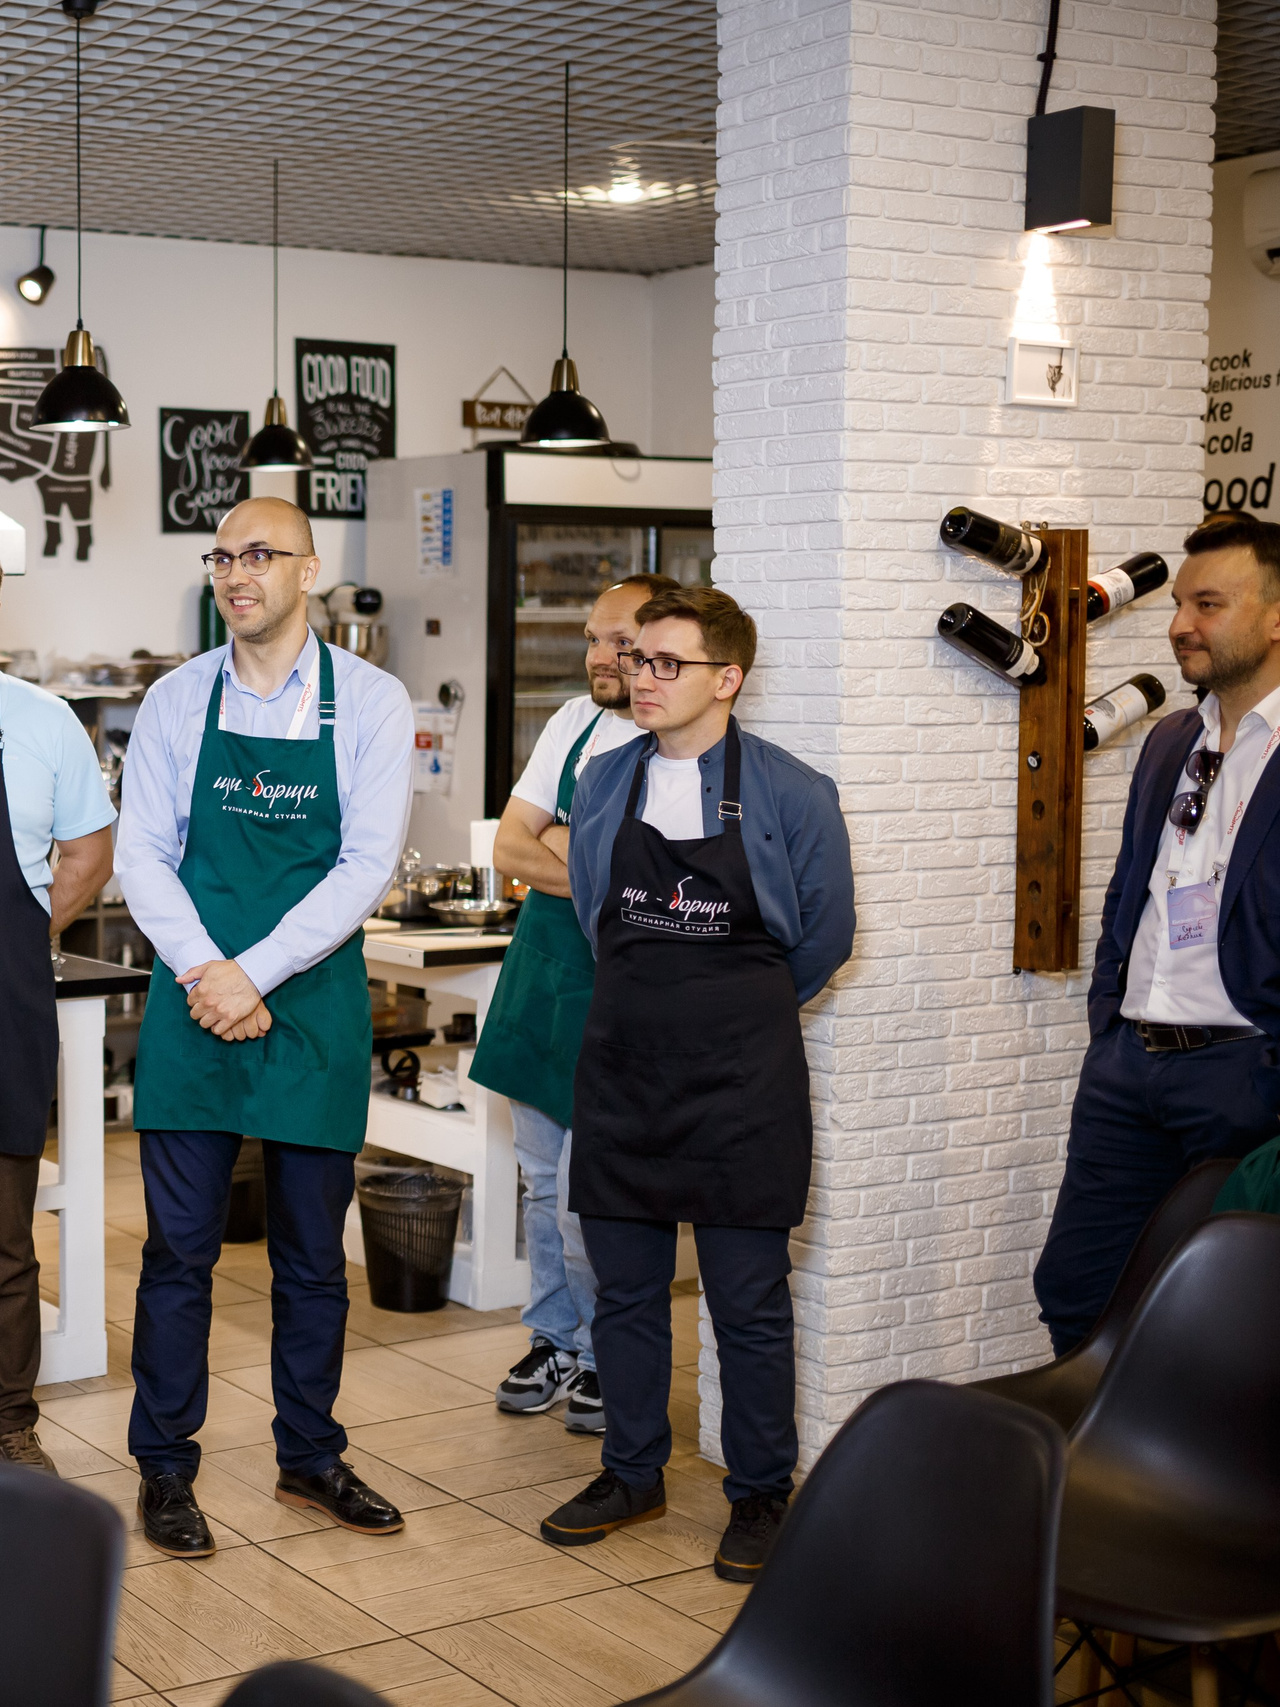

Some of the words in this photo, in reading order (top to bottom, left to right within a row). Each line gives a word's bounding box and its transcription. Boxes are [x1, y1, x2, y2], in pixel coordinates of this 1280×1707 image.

[1210, 348, 1253, 372] cook
[302, 352, 348, 404] GOOD
[350, 354, 391, 408] FOOD
[1201, 397, 1233, 422] ke
[1202, 426, 1254, 455] cola
[309, 471, 366, 511] FRIE
[1203, 462, 1276, 513] ood
[629, 914, 680, 929] КУЛИНАРНАЯ
